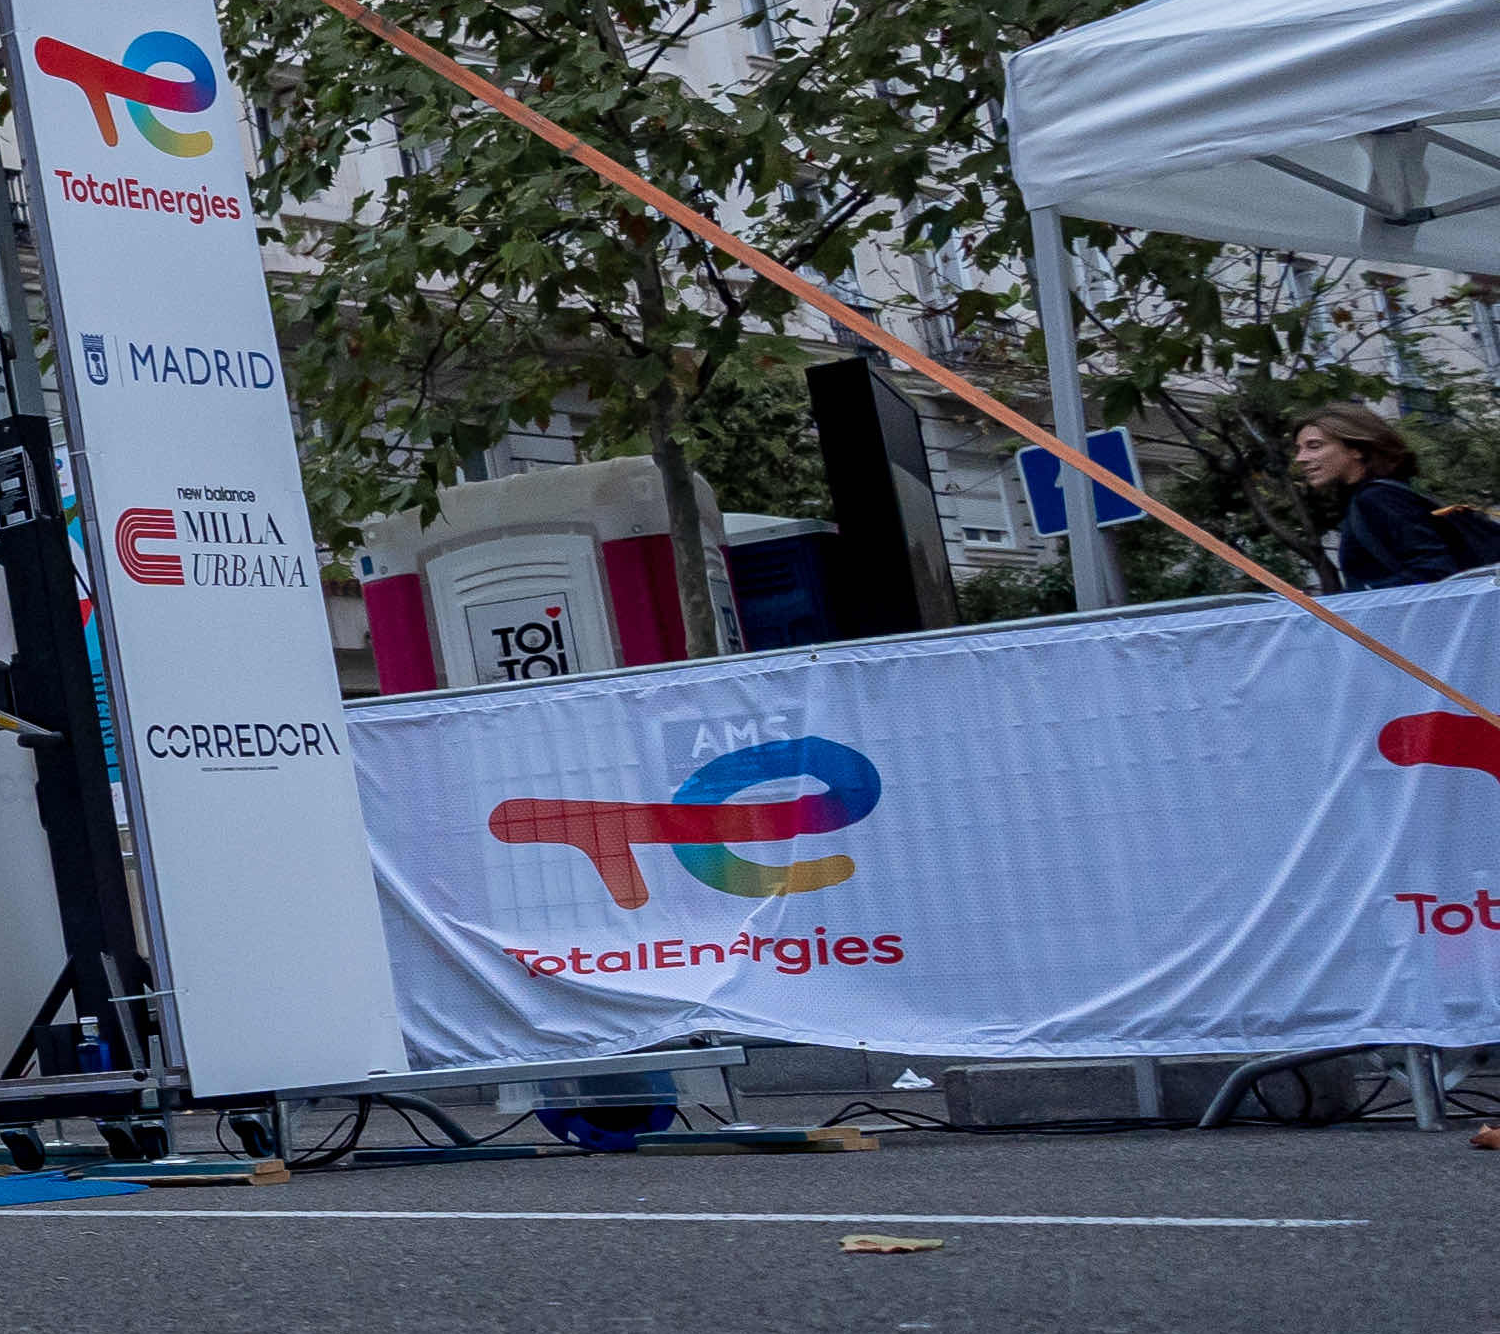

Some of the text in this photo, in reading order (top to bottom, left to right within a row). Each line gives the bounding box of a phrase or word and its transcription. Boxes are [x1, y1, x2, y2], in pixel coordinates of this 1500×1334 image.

[54, 169, 241, 224] TotalEnergies
[128, 341, 275, 390] MADRID
[177, 484, 256, 503] new balance
[181, 510, 288, 545] MILLA
[191, 552, 309, 588] URBANA
